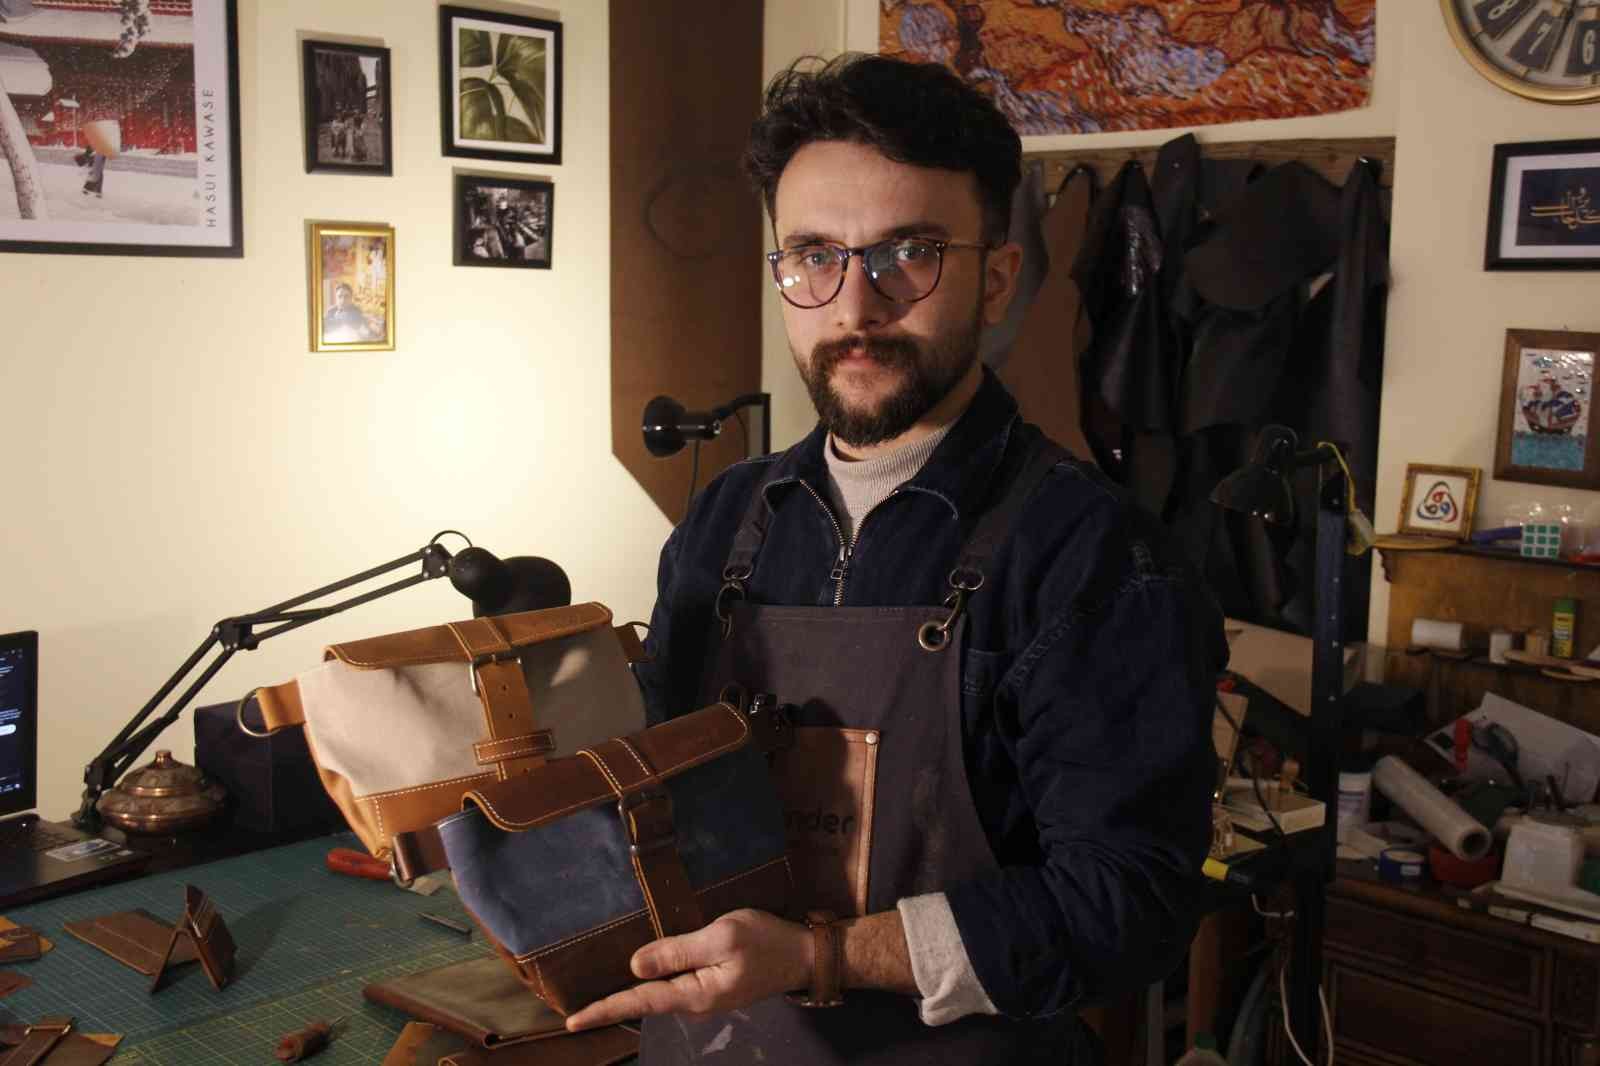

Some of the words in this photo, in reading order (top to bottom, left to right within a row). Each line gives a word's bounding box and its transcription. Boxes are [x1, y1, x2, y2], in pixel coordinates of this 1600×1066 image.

[1528, 23, 1552, 55] 7
[1582, 29, 1596, 65] 6
[202, 88, 216, 162] KAWASE
[205, 173, 217, 228] HASUI
